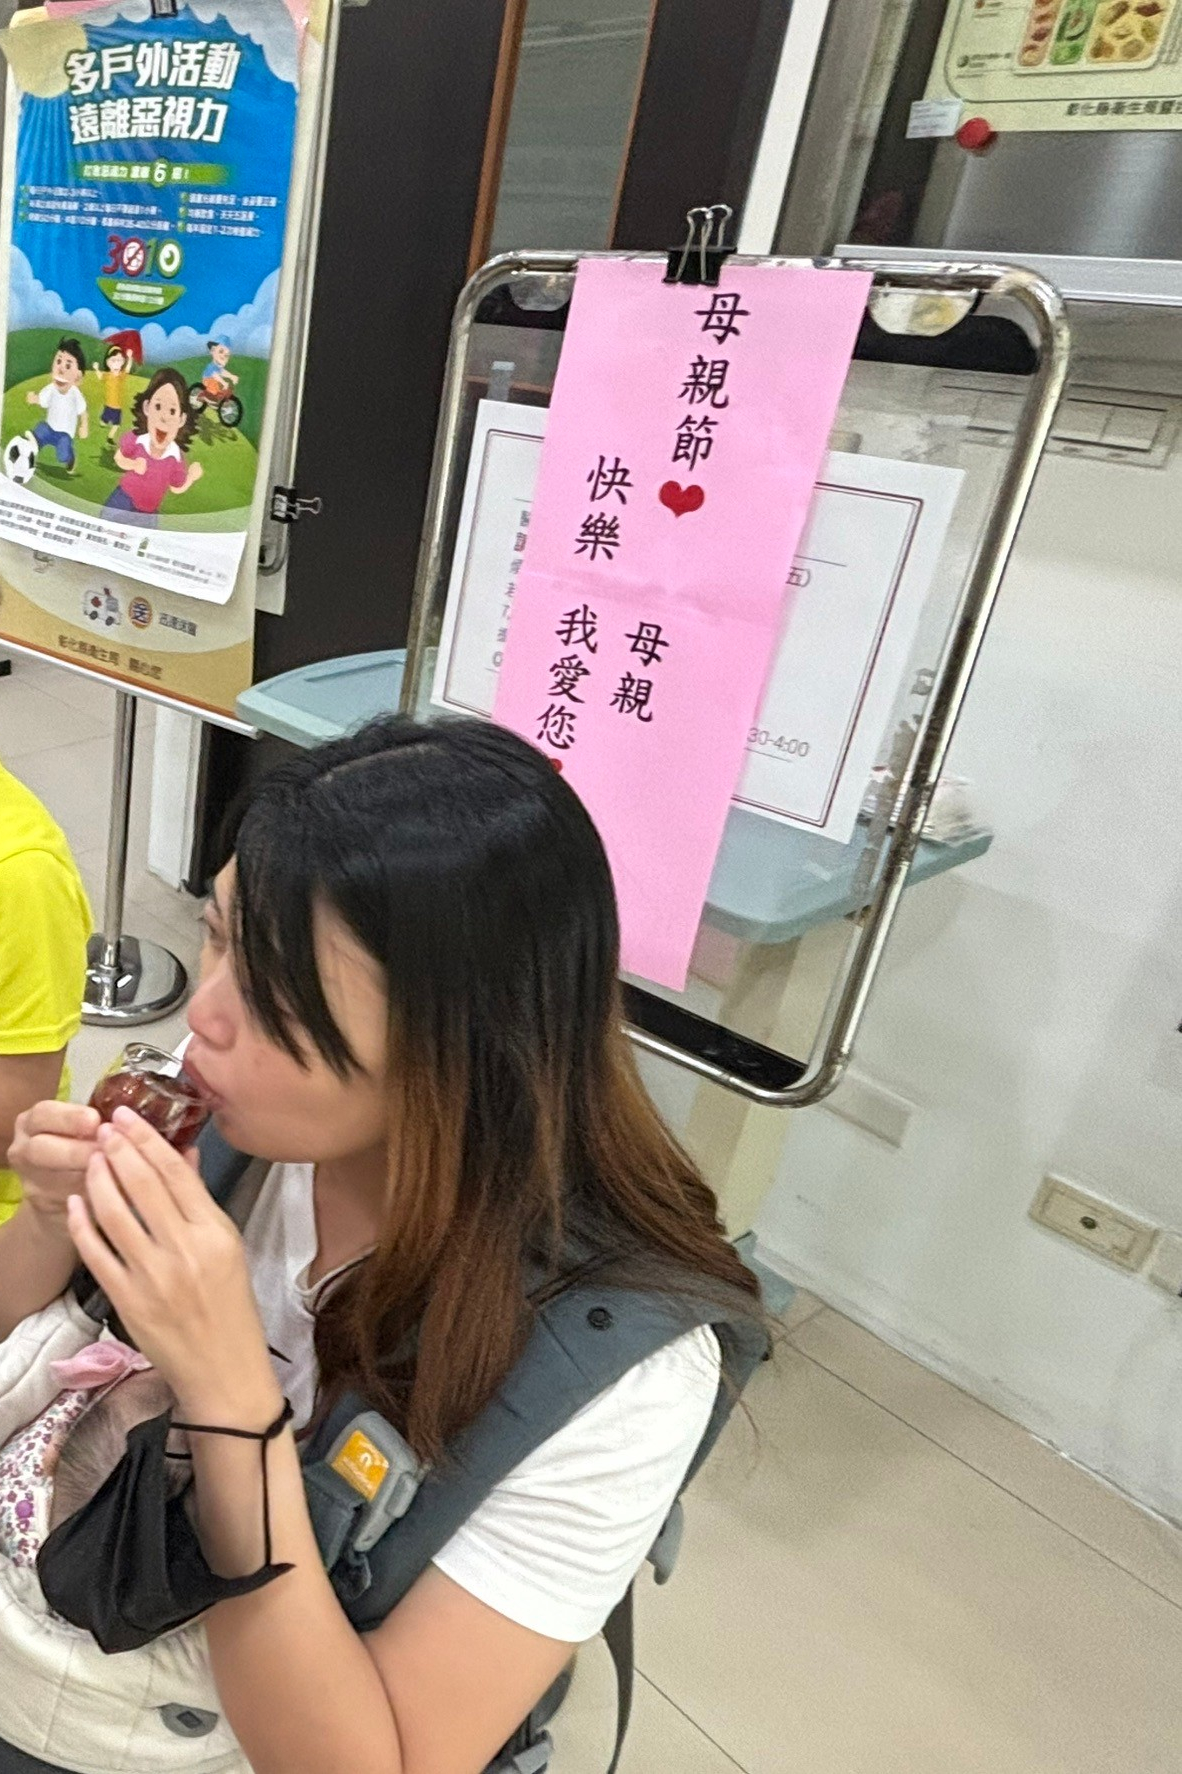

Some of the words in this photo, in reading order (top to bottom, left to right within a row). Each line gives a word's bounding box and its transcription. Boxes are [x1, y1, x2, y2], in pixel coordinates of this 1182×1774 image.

[65, 41, 242, 97] 多戶外活動
[69, 96, 229, 144] 遠離惡視力
[153, 161, 167, 183] 6
[670, 292, 751, 472] 母親節
[573, 454, 634, 561] 快樂
[536, 602, 600, 752] 我愛您
[609, 620, 671, 724] 母親
